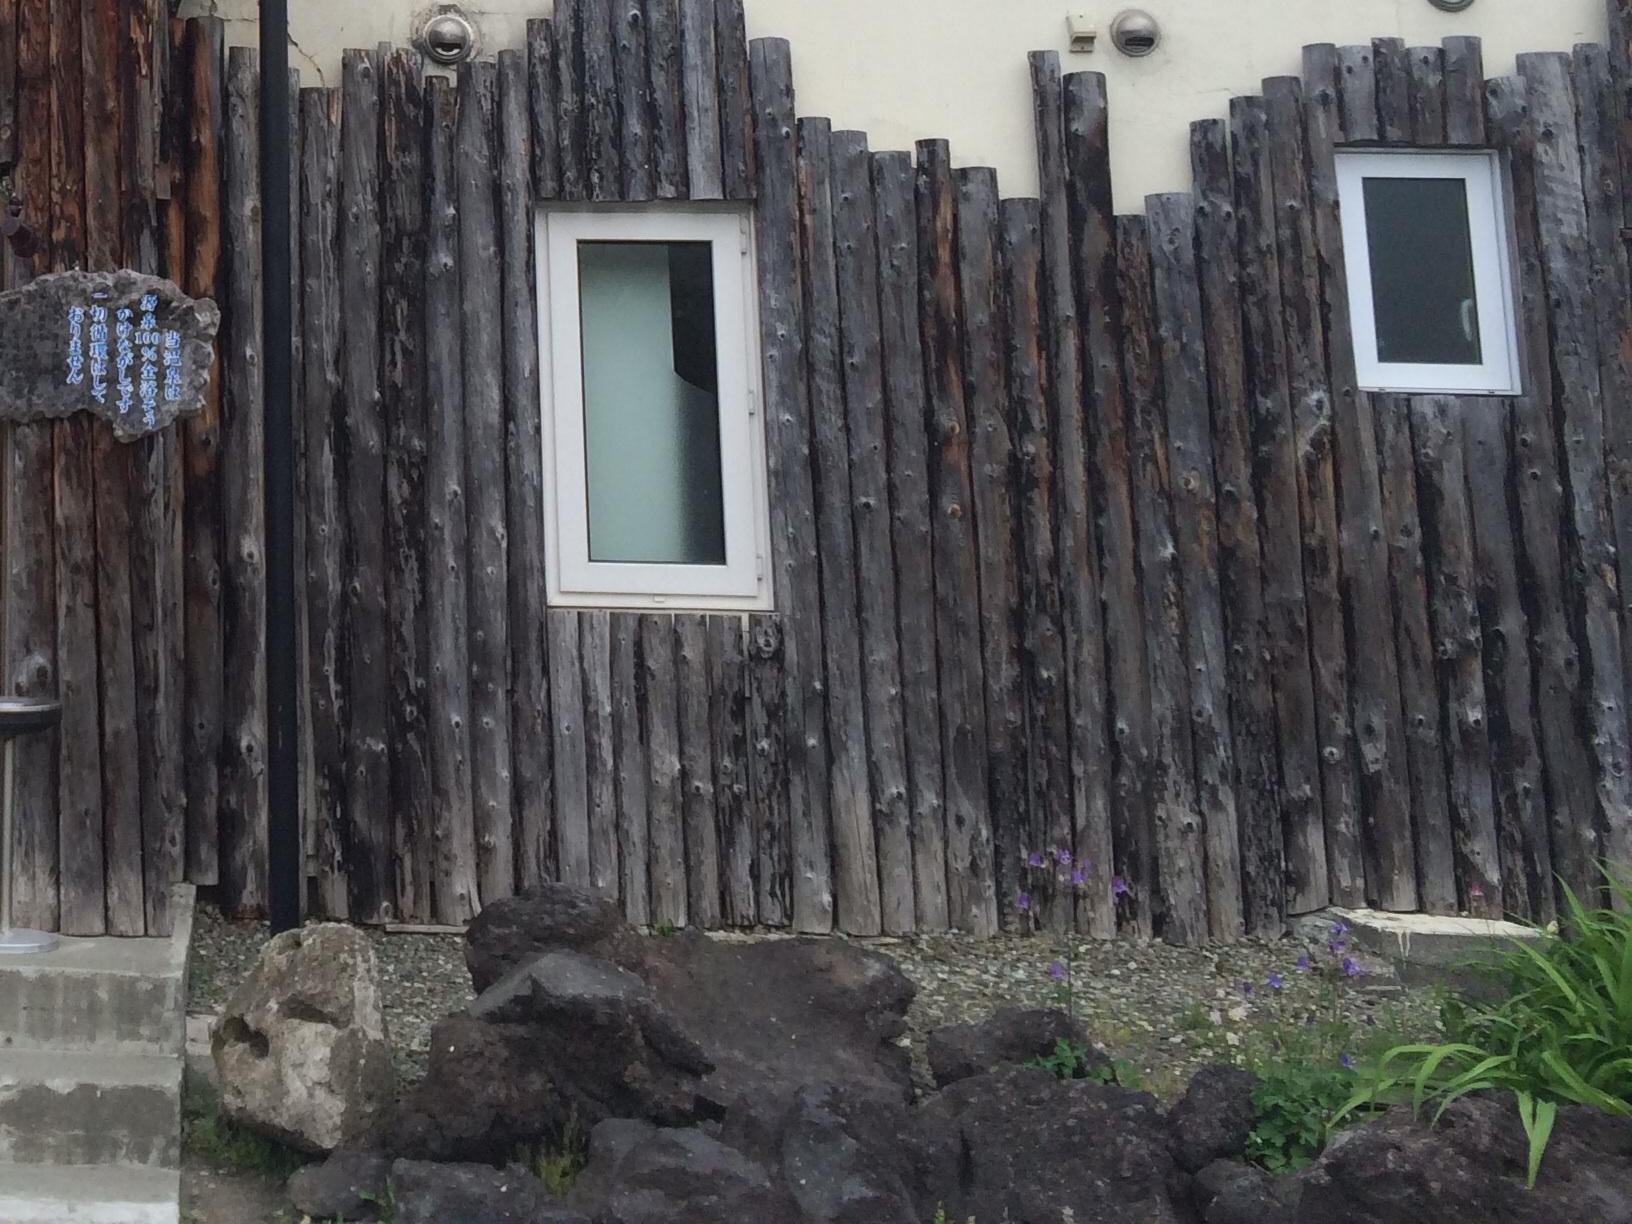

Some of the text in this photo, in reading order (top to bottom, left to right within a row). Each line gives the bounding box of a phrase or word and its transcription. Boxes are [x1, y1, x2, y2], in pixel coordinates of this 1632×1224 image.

[66, 306, 84, 385] おりません
[89, 292, 109, 404] 一切循環はして
[116, 307, 134, 414] かけながしです
[163, 330, 182, 401] 当温泉は
